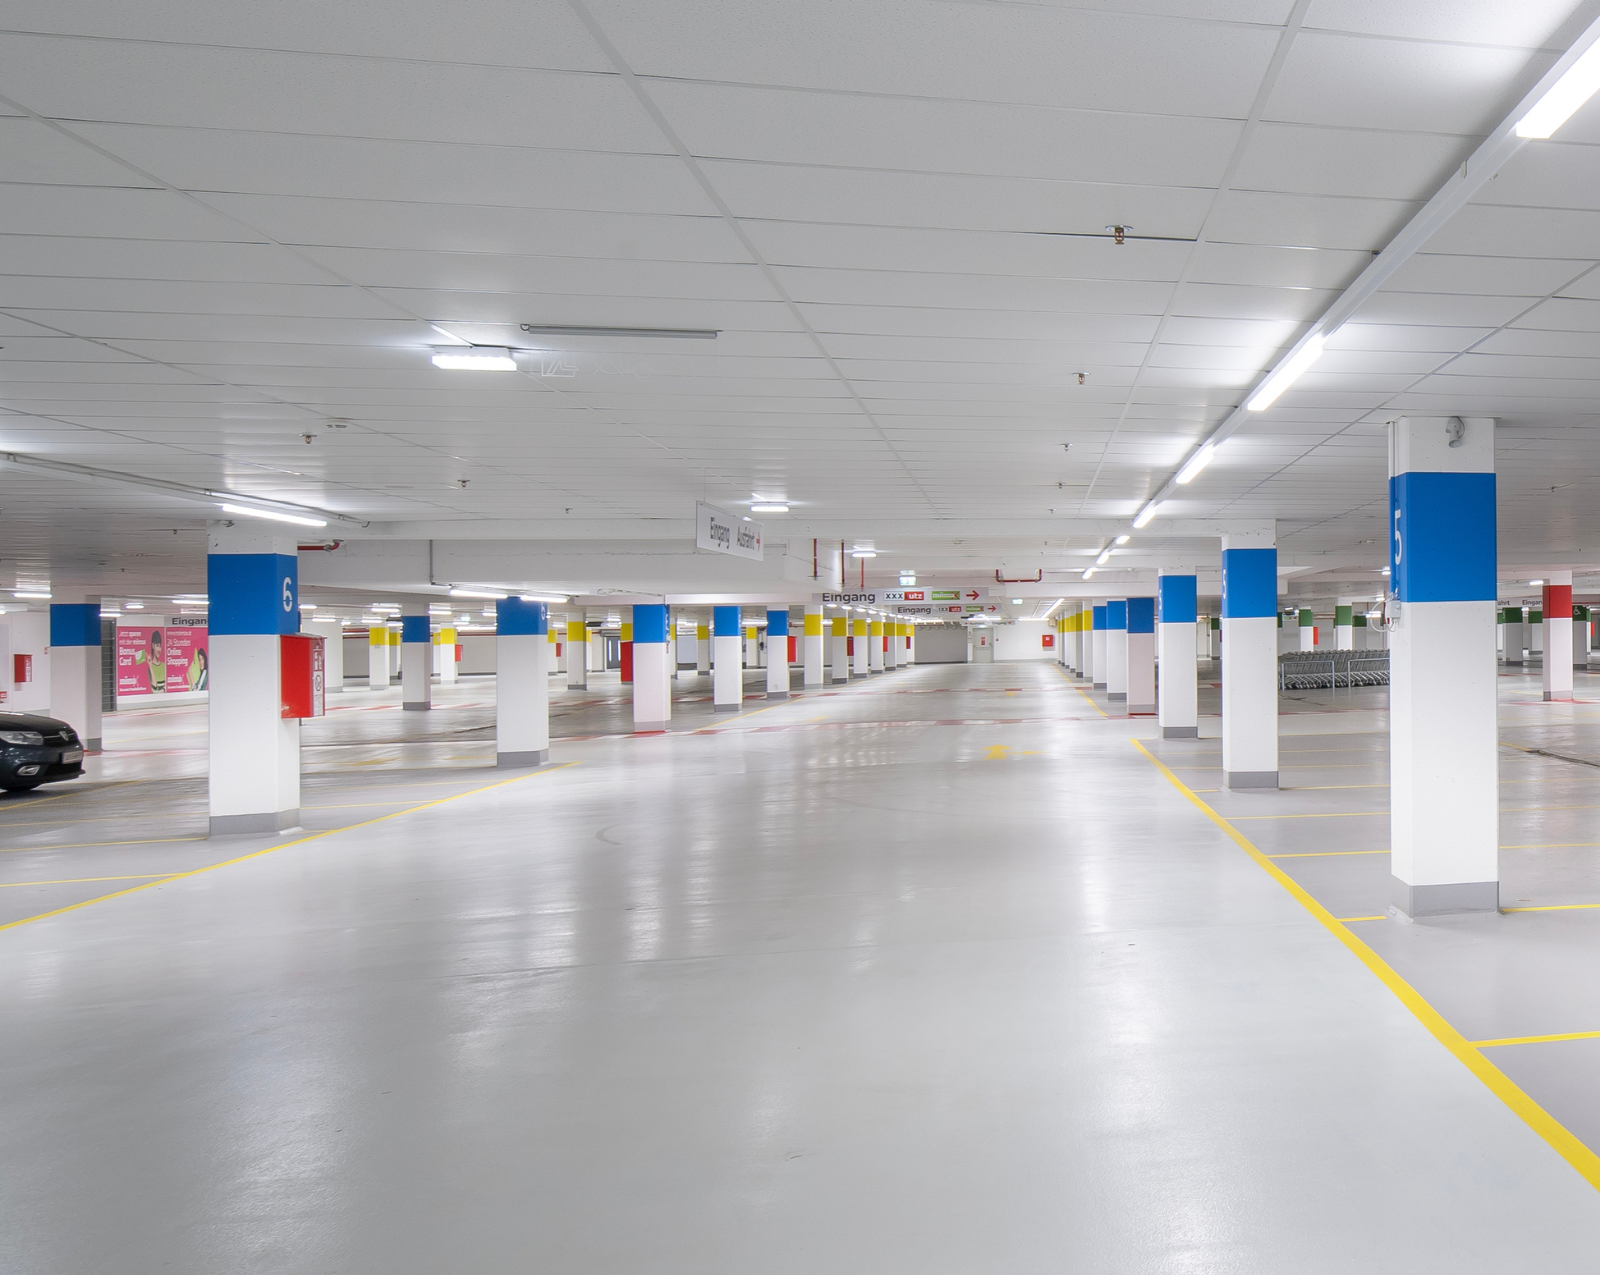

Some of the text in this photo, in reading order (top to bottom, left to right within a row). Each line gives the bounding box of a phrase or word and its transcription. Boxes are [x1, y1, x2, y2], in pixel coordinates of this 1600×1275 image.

[710, 516, 730, 550] Eingang
[1394, 509, 1402, 565] 5
[282, 576, 293, 612] 6
[822, 592, 876, 604] Eingang
[897, 606, 931, 615] Eingang
[172, 617, 207, 626] Eingan
[119, 647, 136, 656] Bonus
[119, 657, 132, 666] Card
